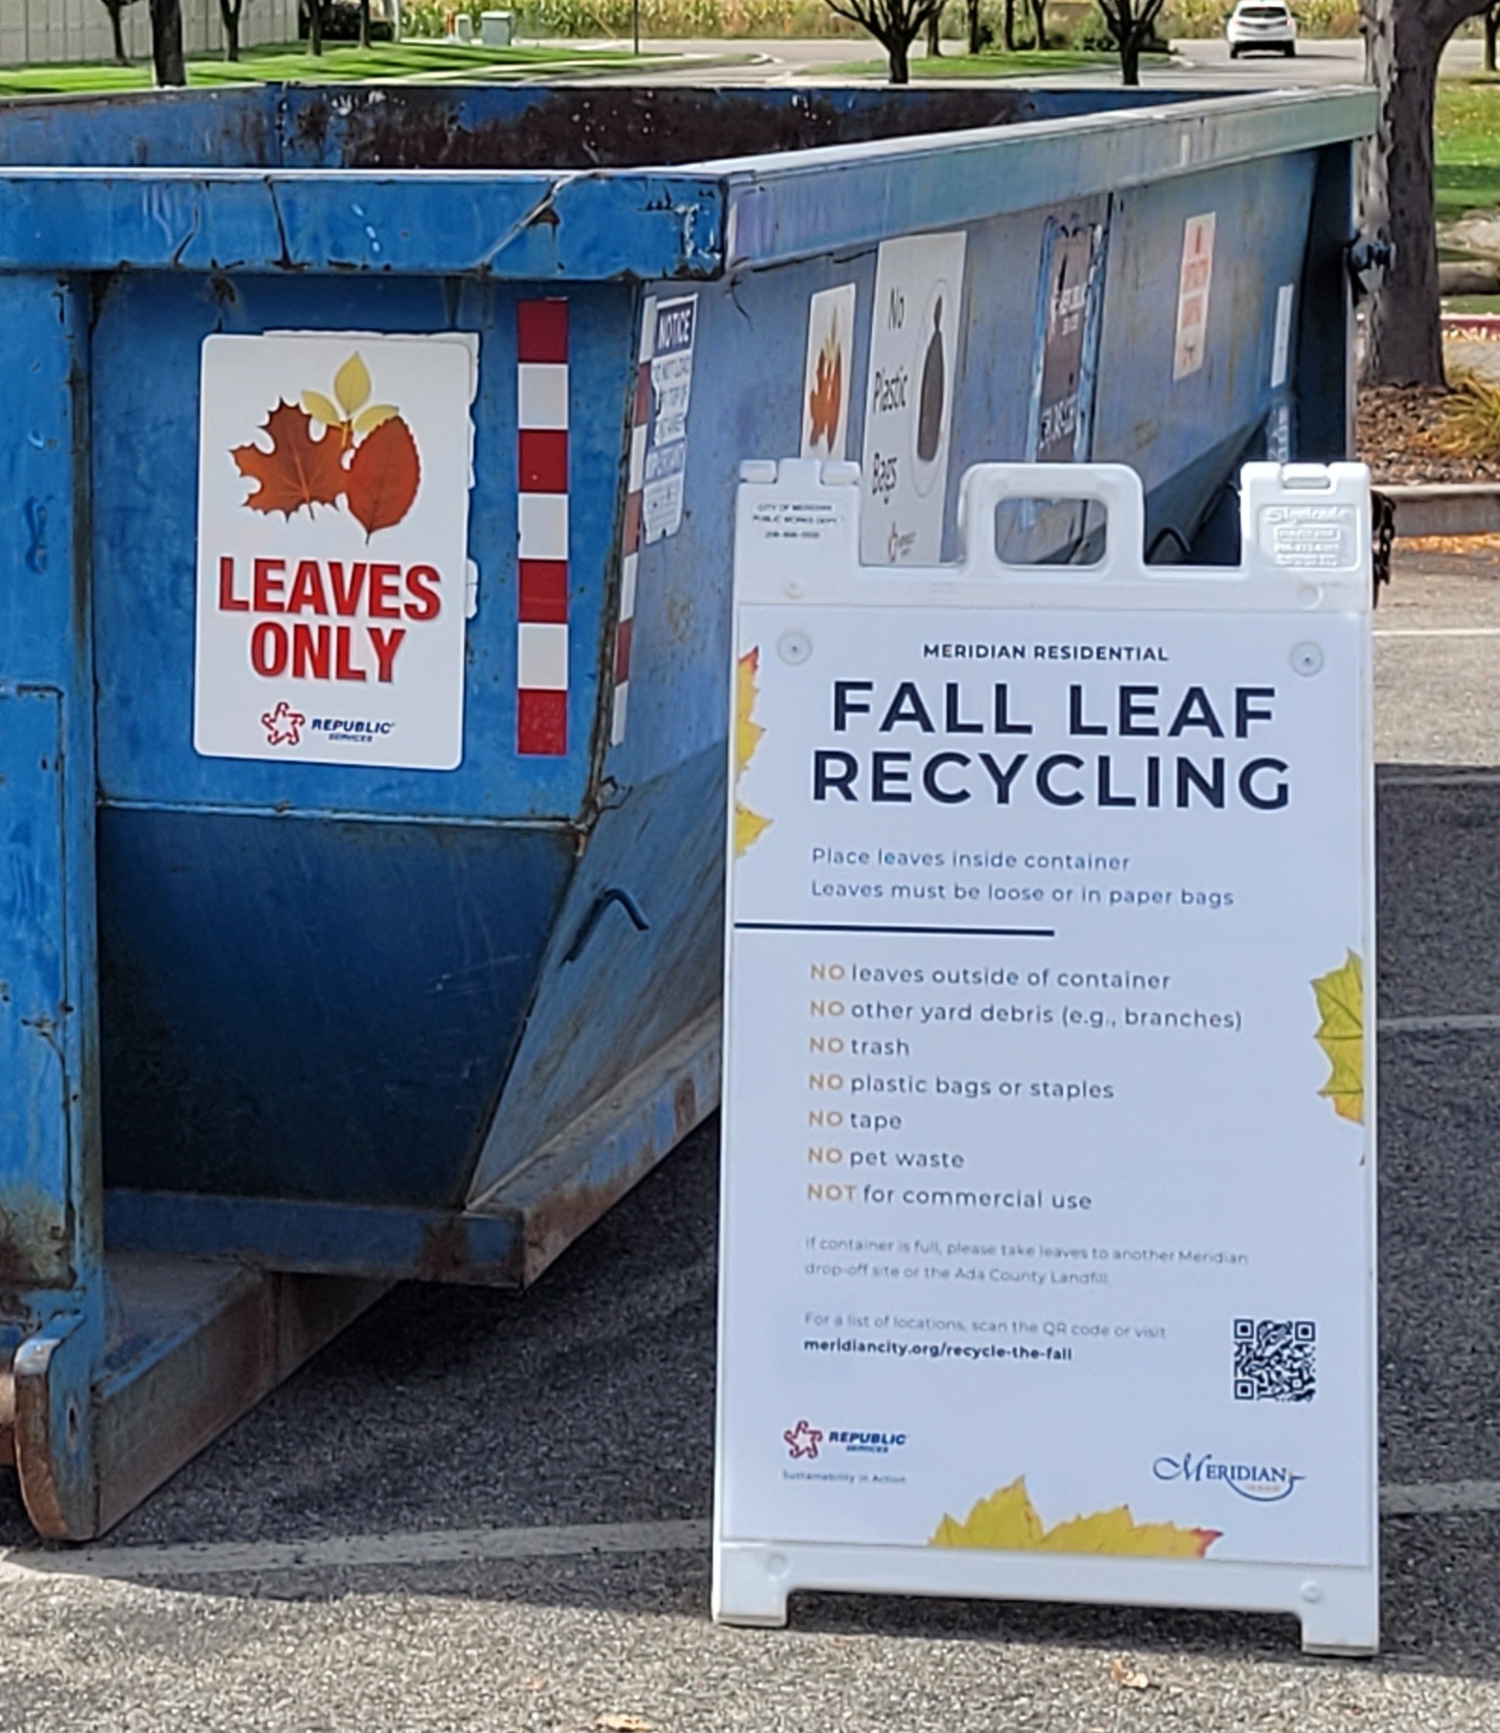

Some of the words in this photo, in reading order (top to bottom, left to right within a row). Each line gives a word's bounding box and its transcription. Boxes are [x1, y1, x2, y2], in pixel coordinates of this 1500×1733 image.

[888, 287, 905, 331] No
[658, 308, 691, 349] NOTICE
[872, 368, 908, 413] Plastic
[872, 452, 898, 505] Bags
[218, 557, 442, 622] LEAVES
[250, 621, 407, 683] ONLY
[924, 643, 1026, 661] MERIDIAN
[1033, 645, 1170, 663] RESIDENTIAL
[833, 680, 1034, 736] FALL
[1068, 684, 1276, 739] LEAF
[311, 718, 393, 735] REPUBLIC
[328, 731, 374, 743] SERVICES
[812, 750, 1291, 812] RECYCLING
[812, 847, 870, 865] Place
[878, 848, 946, 867] leaves
[952, 850, 1017, 868] inside
[1024, 853, 1131, 872] container
[811, 880, 884, 898] Leaves
[891, 883, 946, 900] must
[954, 882, 980, 900] be
[988, 883, 1045, 901] loose
[1051, 887, 1074, 902] or
[1082, 885, 1102, 904] in
[1109, 888, 1172, 907] paper
[1181, 887, 1235, 910] bags
[810, 963, 845, 981] NO
[851, 963, 925, 984] leaves
[932, 966, 1019, 986] outside
[1027, 967, 1050, 987] of
[1057, 970, 1171, 990] container
[810, 1000, 845, 1017] NO
[851, 1000, 914, 1019] other
[920, 1002, 972, 1024] yard
[981, 1004, 1054, 1024] debris
[1062, 1005, 1117, 1029] (e.g.,
[1125, 1007, 1242, 1032] branches)
[809, 1036, 845, 1054] NO
[851, 1038, 910, 1057] trash
[808, 1073, 844, 1091] NO
[851, 1074, 928, 1096] plastic
[936, 1075, 992, 1099] bags
[998, 1081, 1022, 1096] or
[1030, 1080, 1116, 1103] staples
[808, 1109, 844, 1128] NO
[850, 1111, 902, 1133] tape
[807, 1147, 843, 1165] NO
[850, 1150, 888, 1170] pet
[895, 1151, 965, 1169] waste
[807, 1183, 857, 1202] NOT
[863, 1183, 895, 1204] for
[902, 1188, 1043, 1209] commercial
[1052, 1193, 1092, 1210] use
[805, 1237, 816, 1250] If
[819, 1237, 894, 1253] container
[898, 1240, 911, 1252] is
[914, 1241, 943, 1256] full,
[946, 1242, 997, 1257] please
[1001, 1243, 1035, 1257] take
[1039, 1245, 1088, 1260] leaves
[1092, 1247, 1109, 1260] to
[1112, 1248, 1175, 1263] another
[1178, 1250, 1249, 1265] Meridian
[805, 1262, 869, 1278] drop-off
[872, 1264, 900, 1278] site
[903, 1266, 920, 1278] or
[925, 1266, 950, 1280] the
[955, 1268, 986, 1281] Ada
[989, 1268, 1046, 1285] County
[805, 1313, 830, 1327] For
[834, 1316, 843, 1327] a
[847, 1314, 870, 1328] list
[874, 1314, 890, 1329] of
[893, 1316, 965, 1332] locations,
[971, 1320, 1008, 1333] scan
[1012, 1320, 1038, 1334] the
[1042, 1322, 1067, 1337] QR
[1071, 1322, 1110, 1338] code
[1113, 1325, 1131, 1338] or
[1135, 1325, 1167, 1340] visit
[803, 1337, 1073, 1362] meridiancity.org/recycle-the-fall
[828, 1430, 907, 1446] REPUBLIC
[782, 1468, 855, 1484] Sustainability
[871, 1473, 907, 1484] Action
